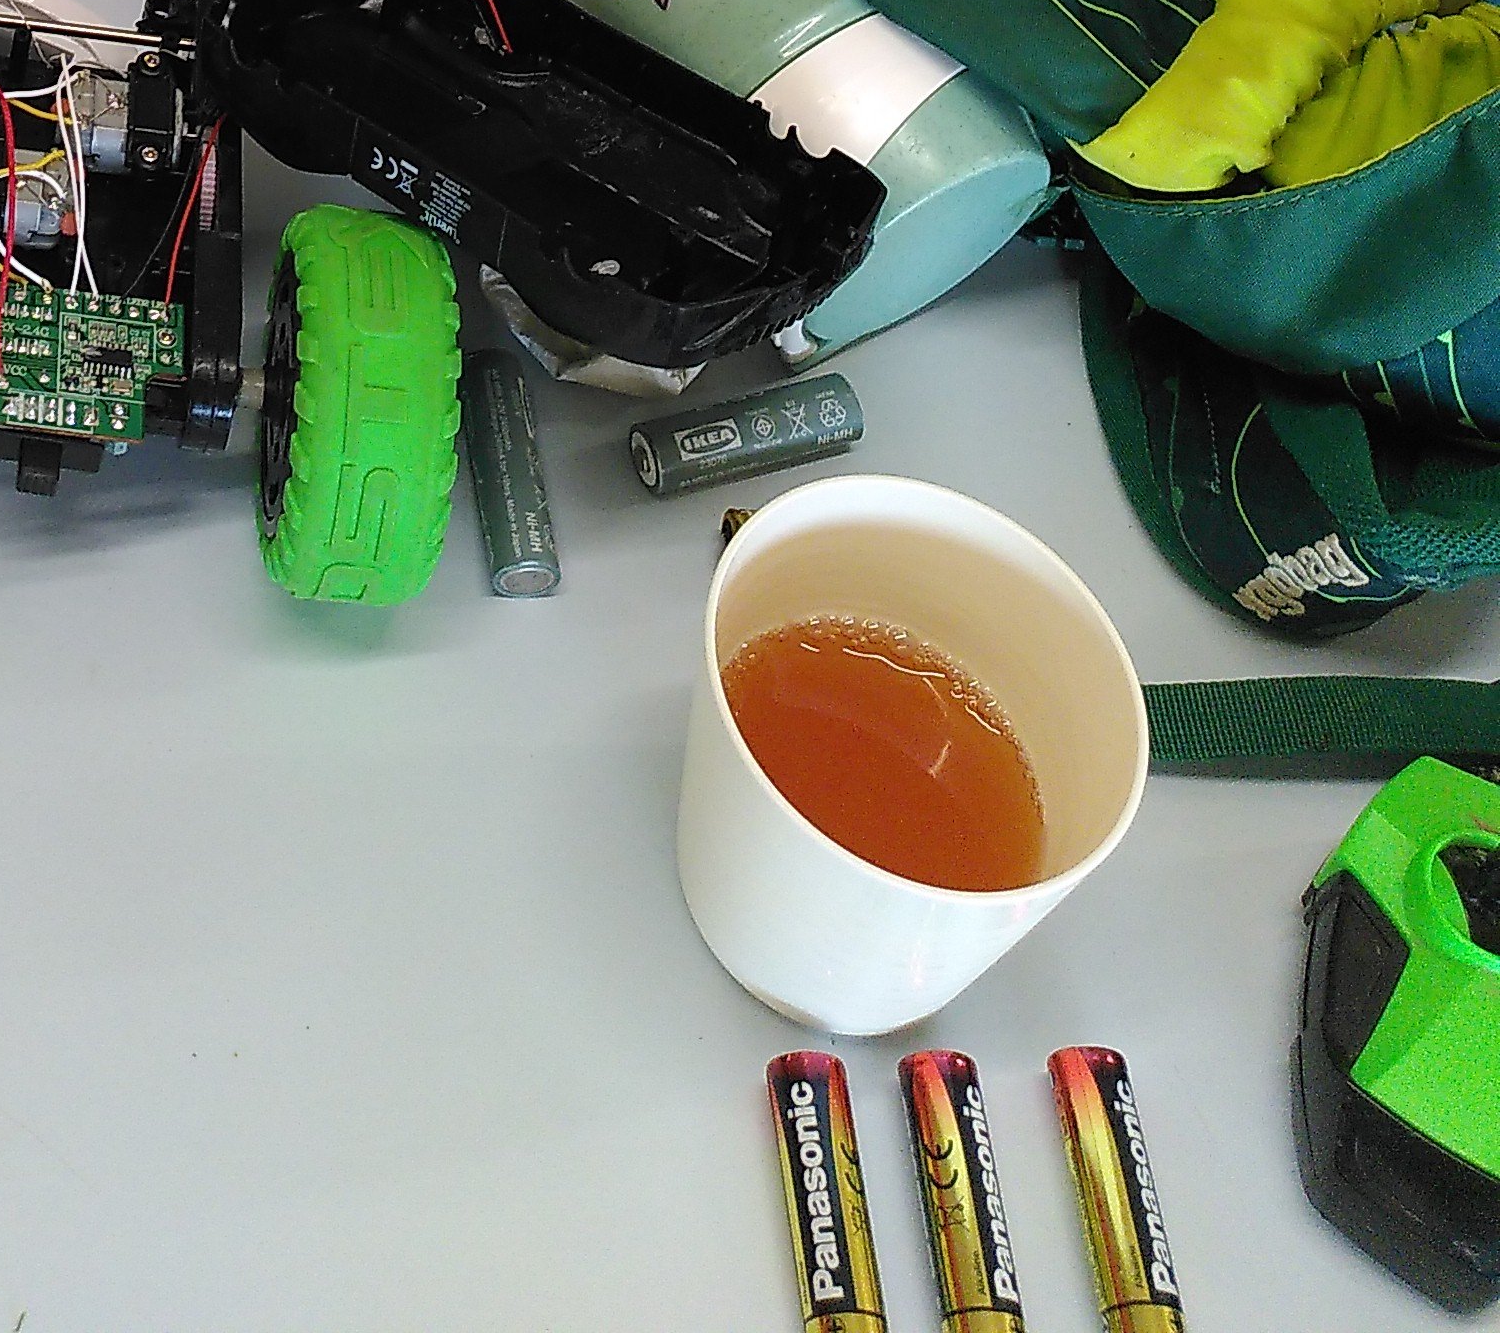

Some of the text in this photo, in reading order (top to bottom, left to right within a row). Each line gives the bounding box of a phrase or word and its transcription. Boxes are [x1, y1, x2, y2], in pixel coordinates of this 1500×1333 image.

[682, 426, 735, 452] IKEA
[787, 1080, 845, 1302] Panasonic
[956, 1084, 1020, 1302] Panasonic
[1112, 1079, 1179, 1295] Panasonic
